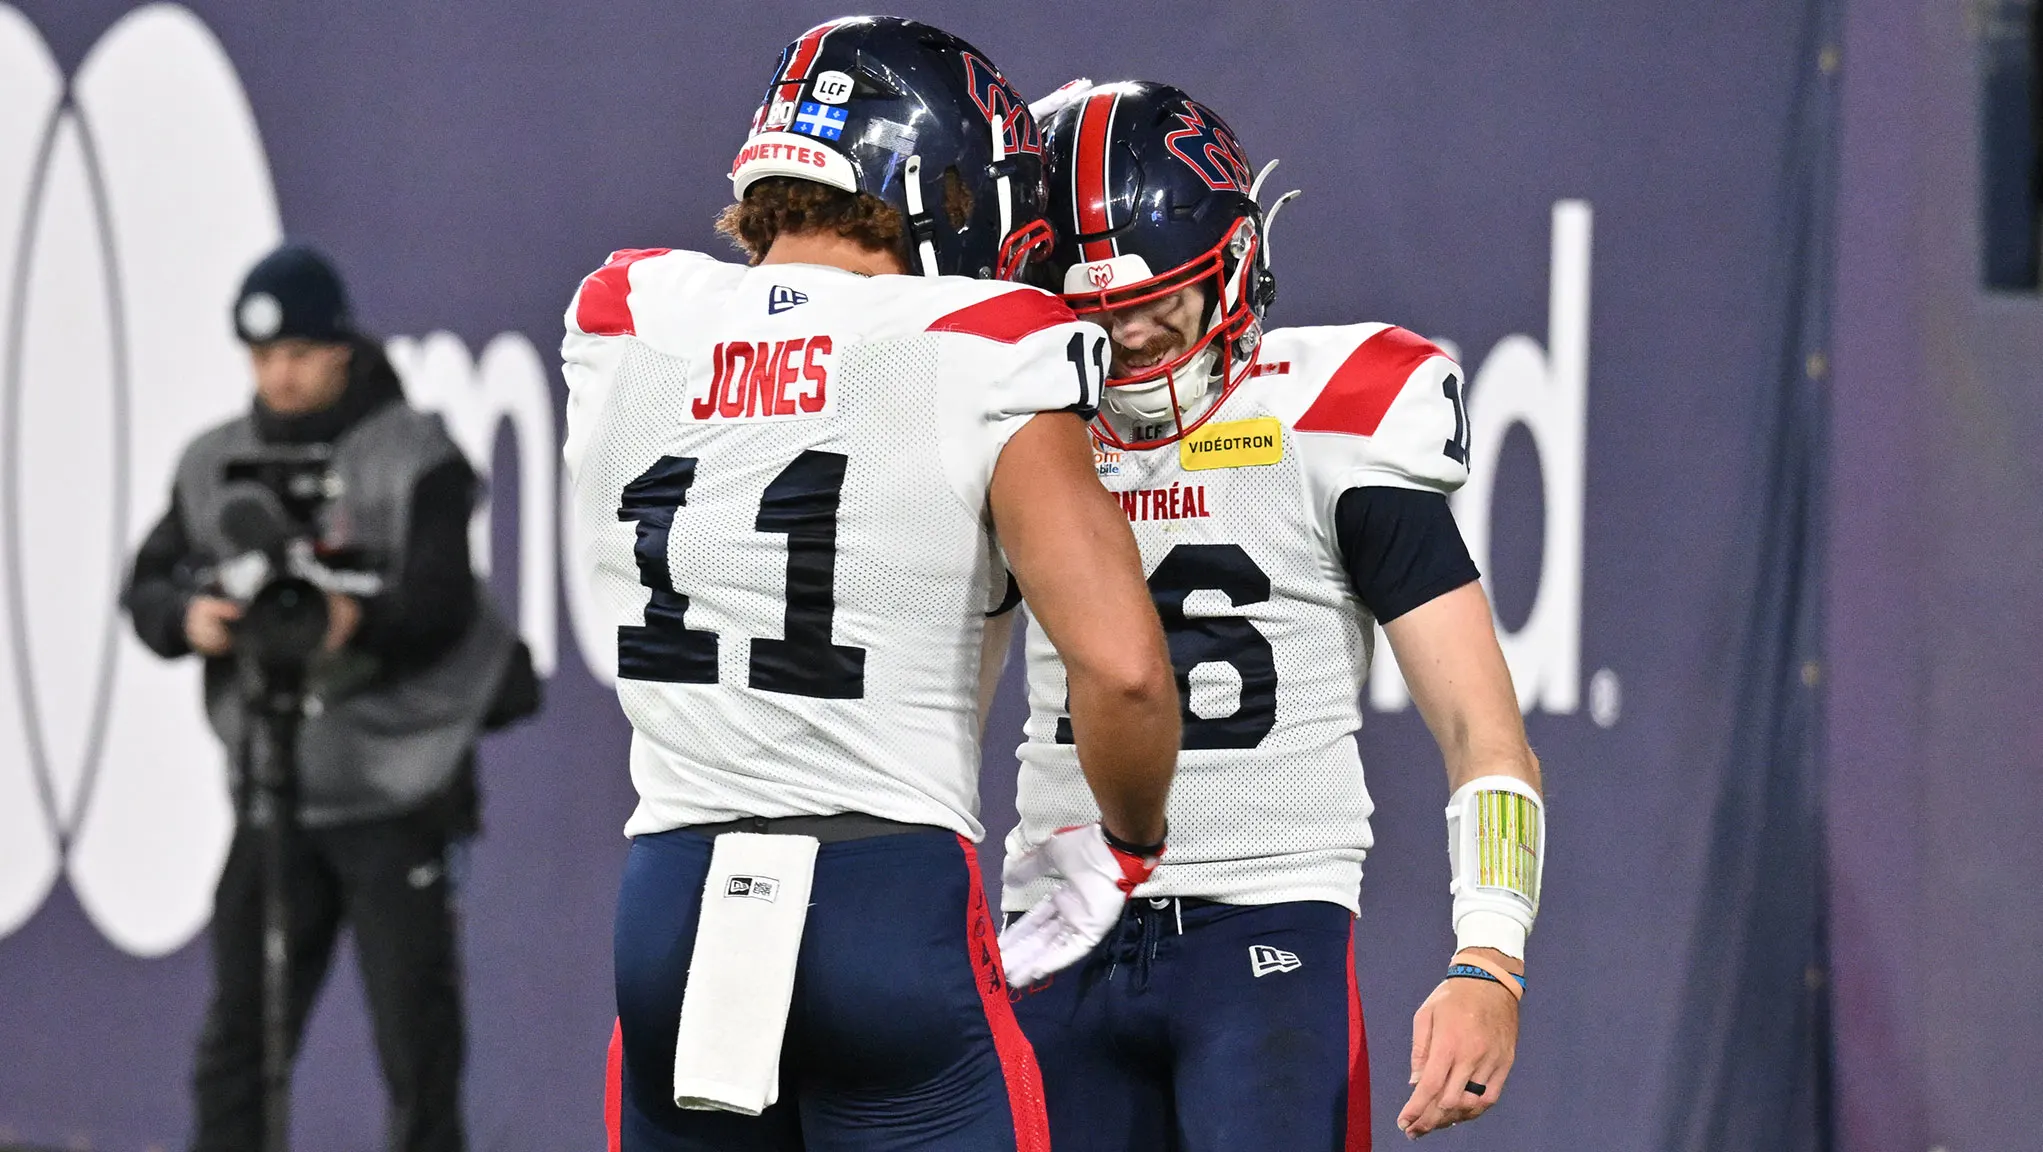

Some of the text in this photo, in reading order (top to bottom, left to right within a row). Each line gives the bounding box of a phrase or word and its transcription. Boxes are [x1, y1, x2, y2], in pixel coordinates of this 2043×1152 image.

[820, 81, 847, 96] LCF
[692, 335, 832, 420] JONES
[1067, 332, 1106, 406] 11
[1137, 425, 1163, 440] LCF
[1442, 373, 1471, 474] 1
[1189, 436, 1273, 453] VIDÉOTRON
[1096, 464, 1119, 474] bile
[1111, 482, 1211, 522] NTRÉAL
[617, 449, 867, 700] 11
